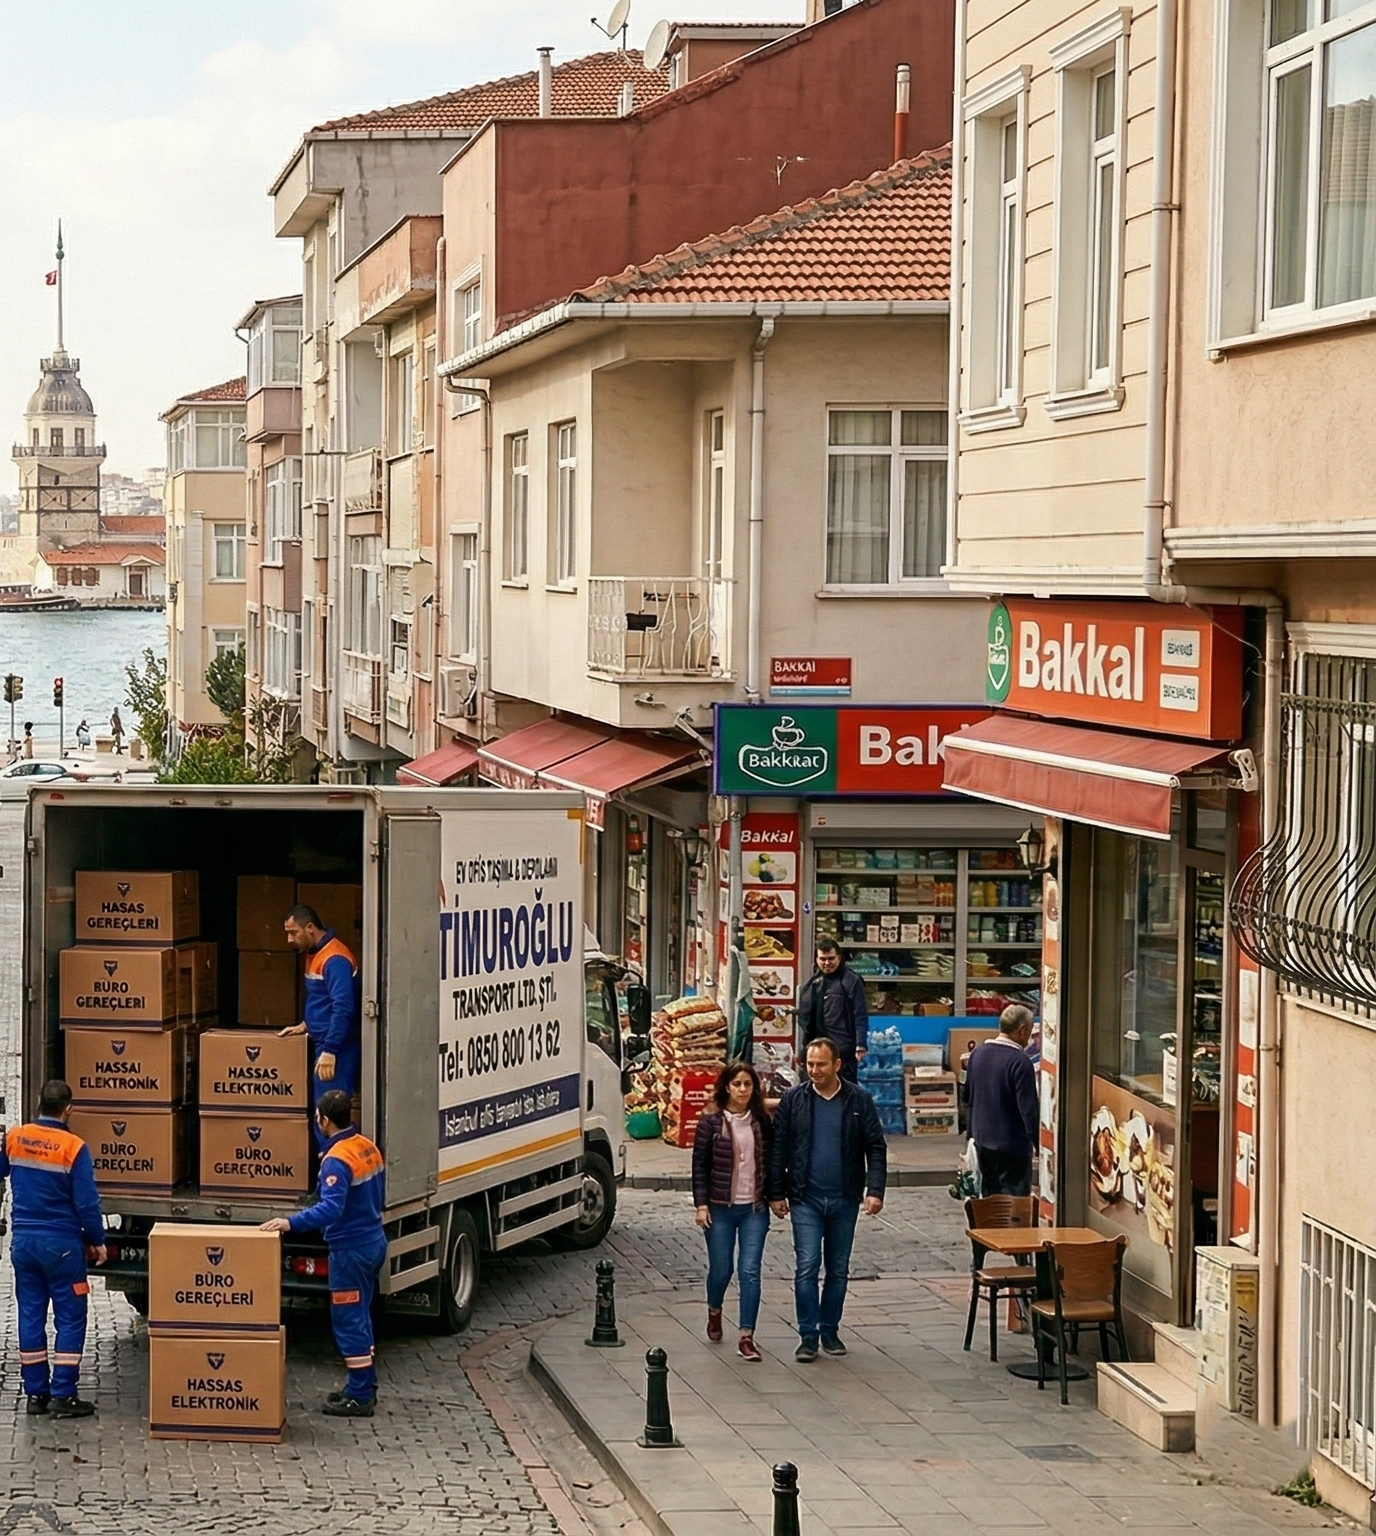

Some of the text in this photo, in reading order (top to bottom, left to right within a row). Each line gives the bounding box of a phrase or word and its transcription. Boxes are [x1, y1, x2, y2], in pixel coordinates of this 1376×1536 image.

[1018, 621, 1144, 701] Bakkal
[860, 724, 970, 766] Bak
[101, 902, 145, 914] HASAS
[87, 916, 159, 931] GEREÇLERİ
[440, 887, 573, 980] TİMUROĞLU
[453, 982, 516, 1021] TRANSPORT
[439, 1019, 561, 1083] Tel: 0850 800 13 62
[228, 1067, 278, 1080] HASSAS
[80, 1076, 159, 1090] ELEKTRONİK
[93, 1157, 154, 1174] EREÇLERİ
[175, 1290, 254, 1307] GEREÇLERİ
[187, 1378, 243, 1393] HASSAS
[171, 1396, 260, 1411] ELEKTRONİK
